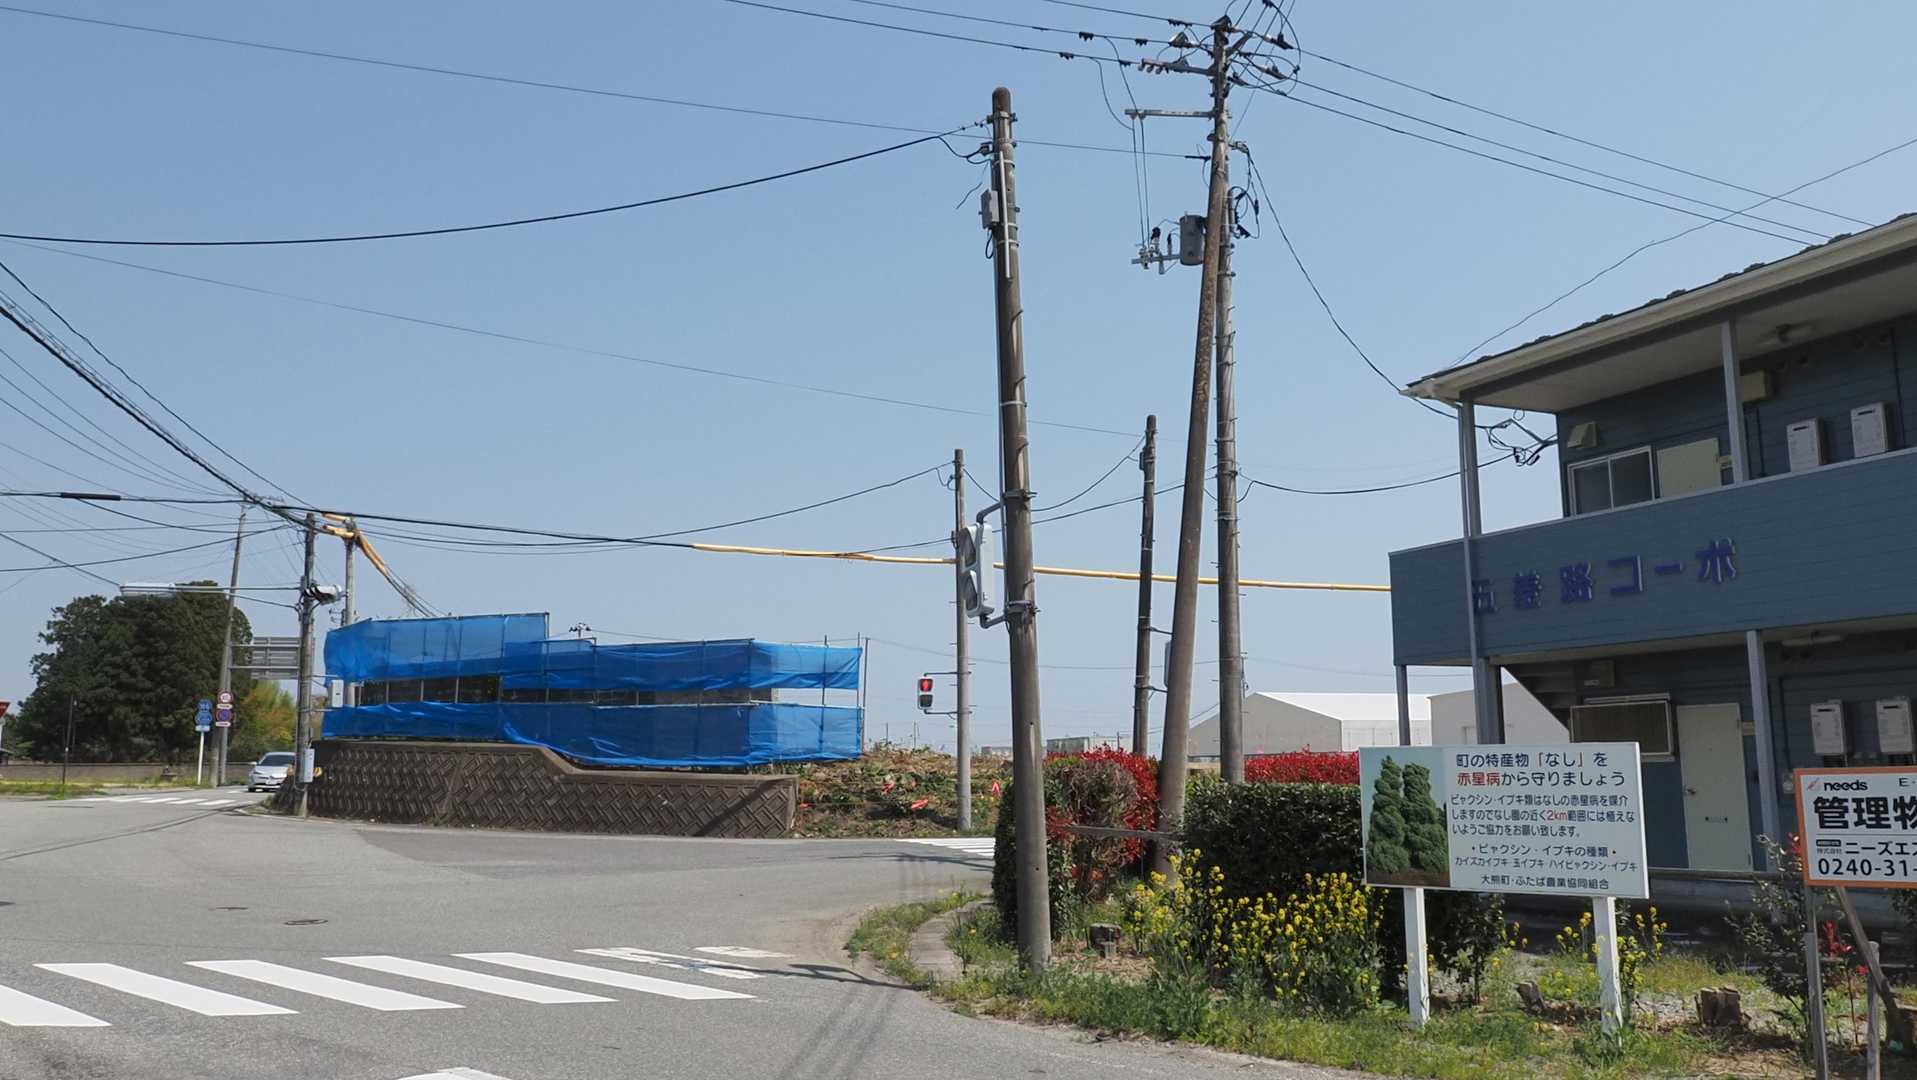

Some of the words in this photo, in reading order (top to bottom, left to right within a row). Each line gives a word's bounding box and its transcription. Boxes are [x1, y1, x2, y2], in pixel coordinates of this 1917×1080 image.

[1457, 771, 1625, 786] 赤星病から守りましょう
[1824, 780, 1868, 791] needs
